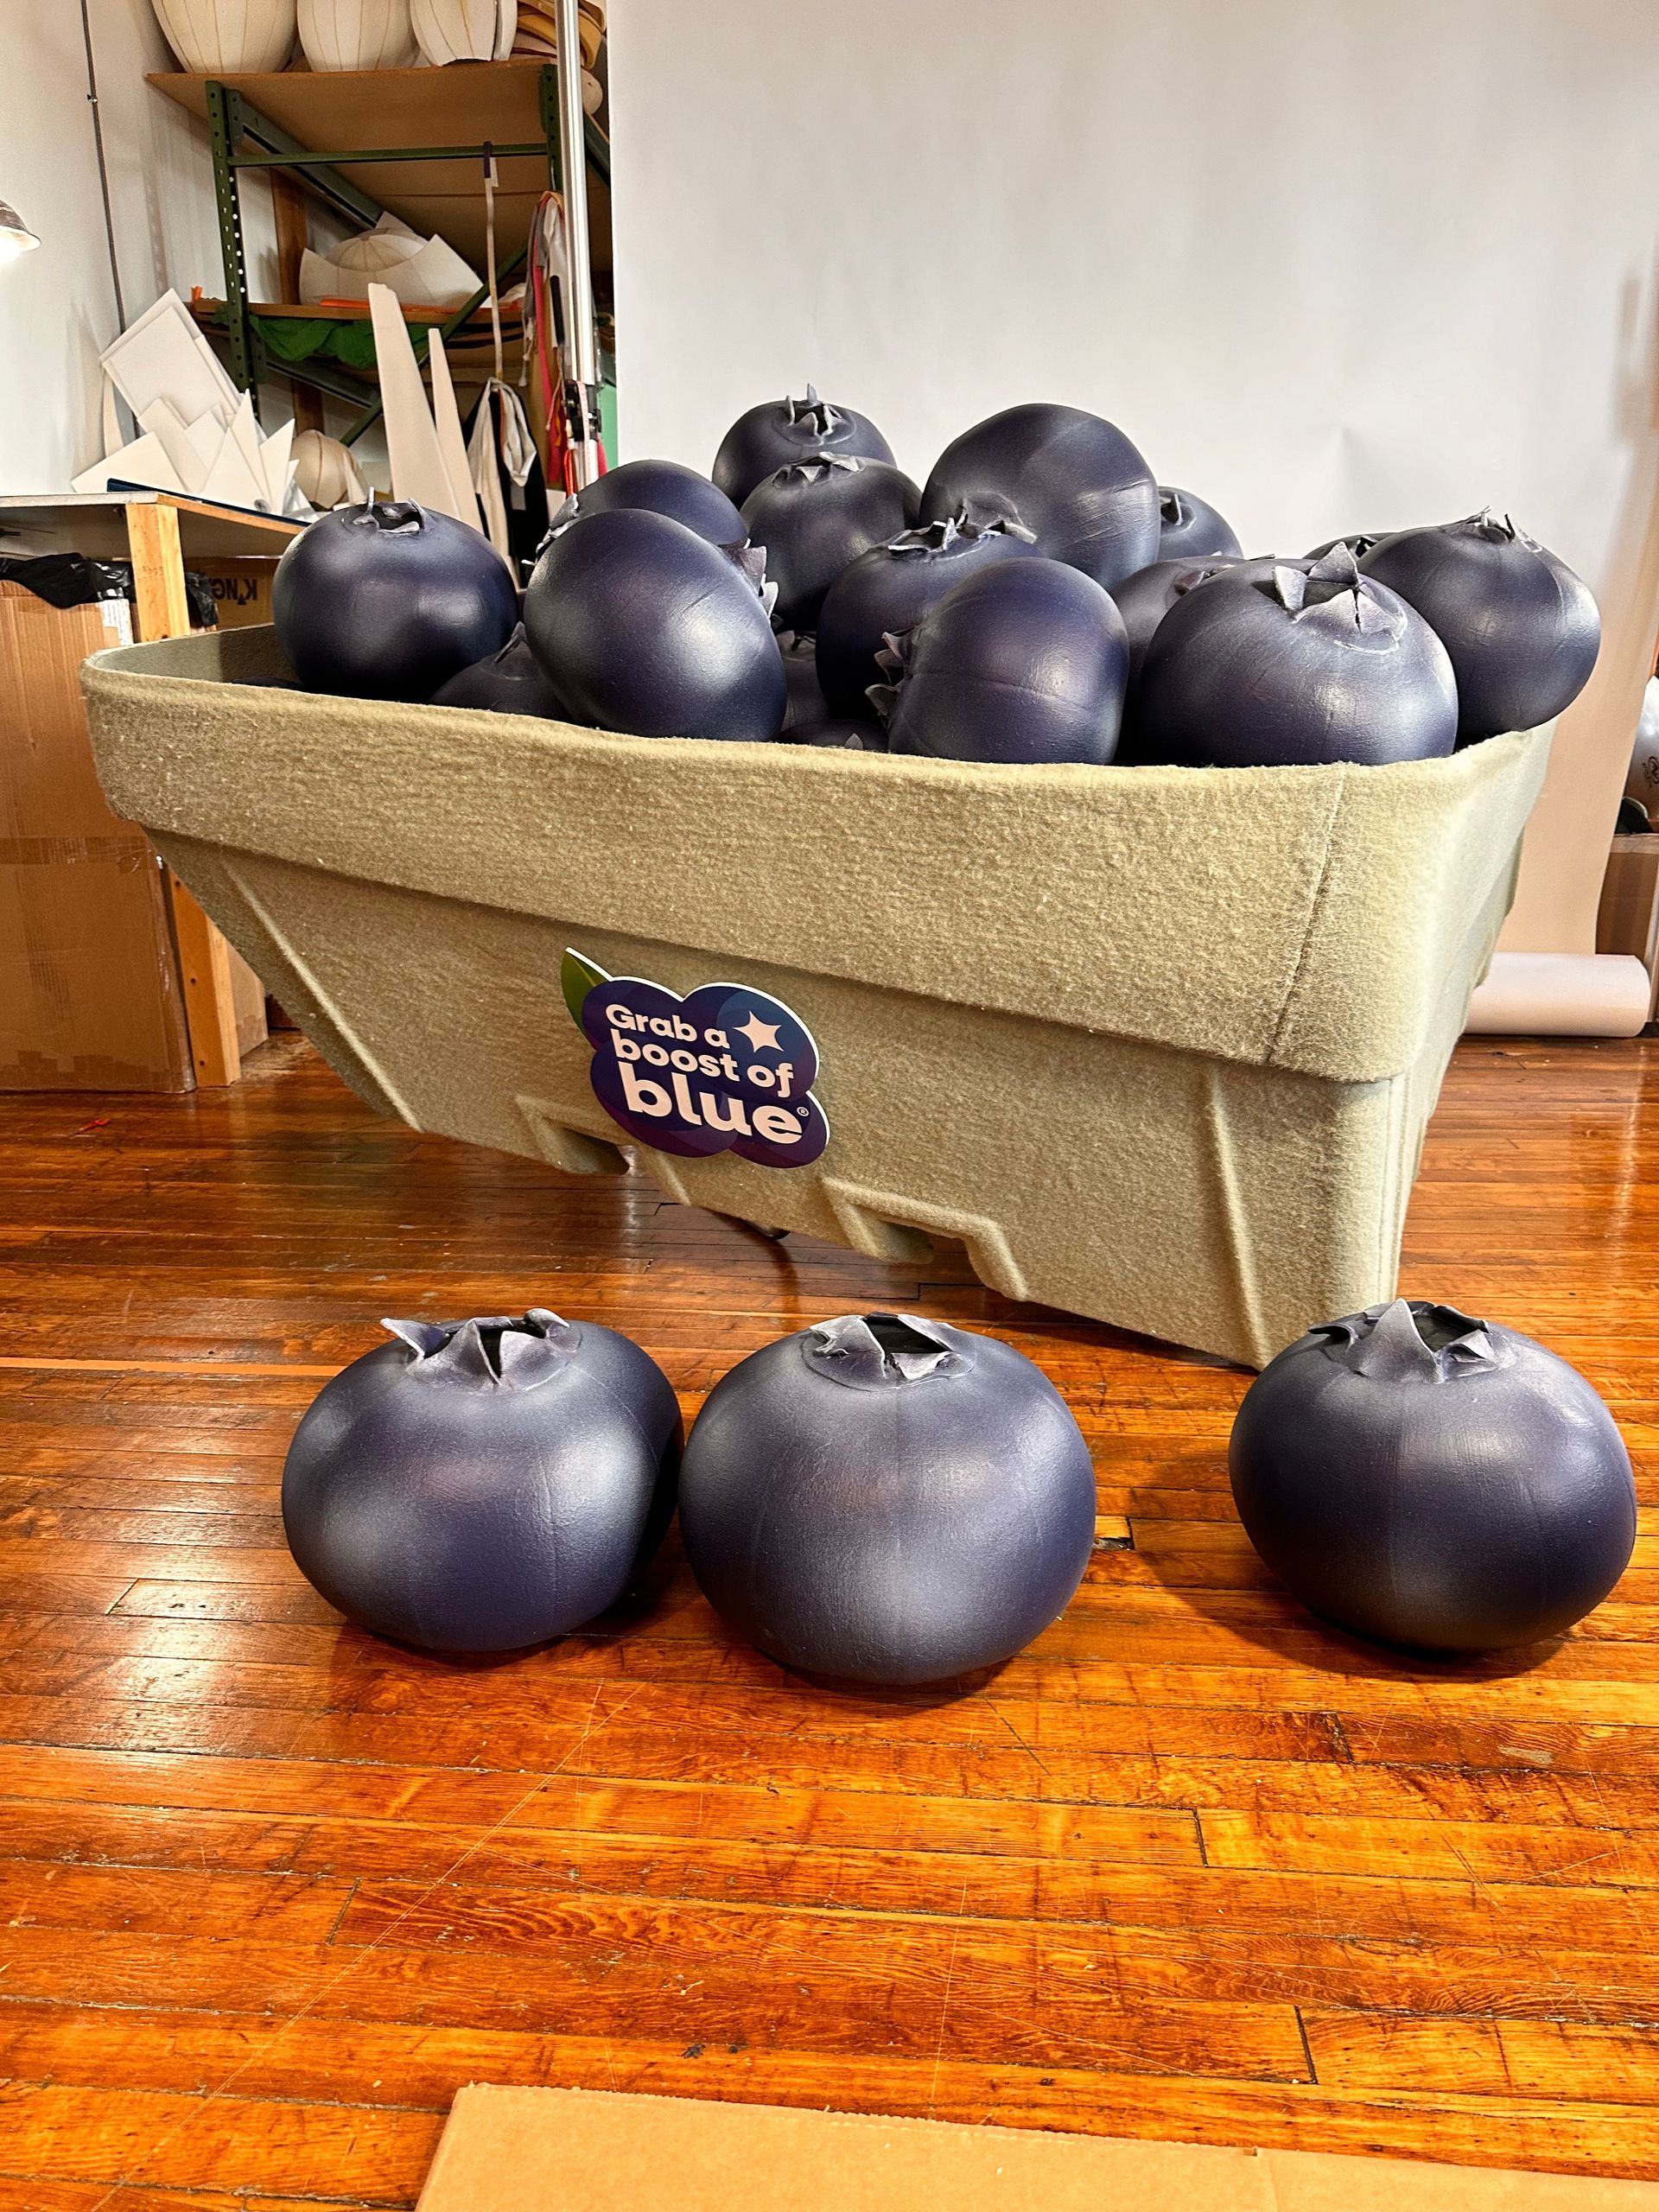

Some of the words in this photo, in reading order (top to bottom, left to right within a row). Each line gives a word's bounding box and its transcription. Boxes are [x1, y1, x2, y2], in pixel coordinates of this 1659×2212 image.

[606, 1004, 697, 1041] Grab
[704, 1026, 730, 1049] a
[610, 1028, 741, 1082] boost
[747, 1063, 794, 1097] of
